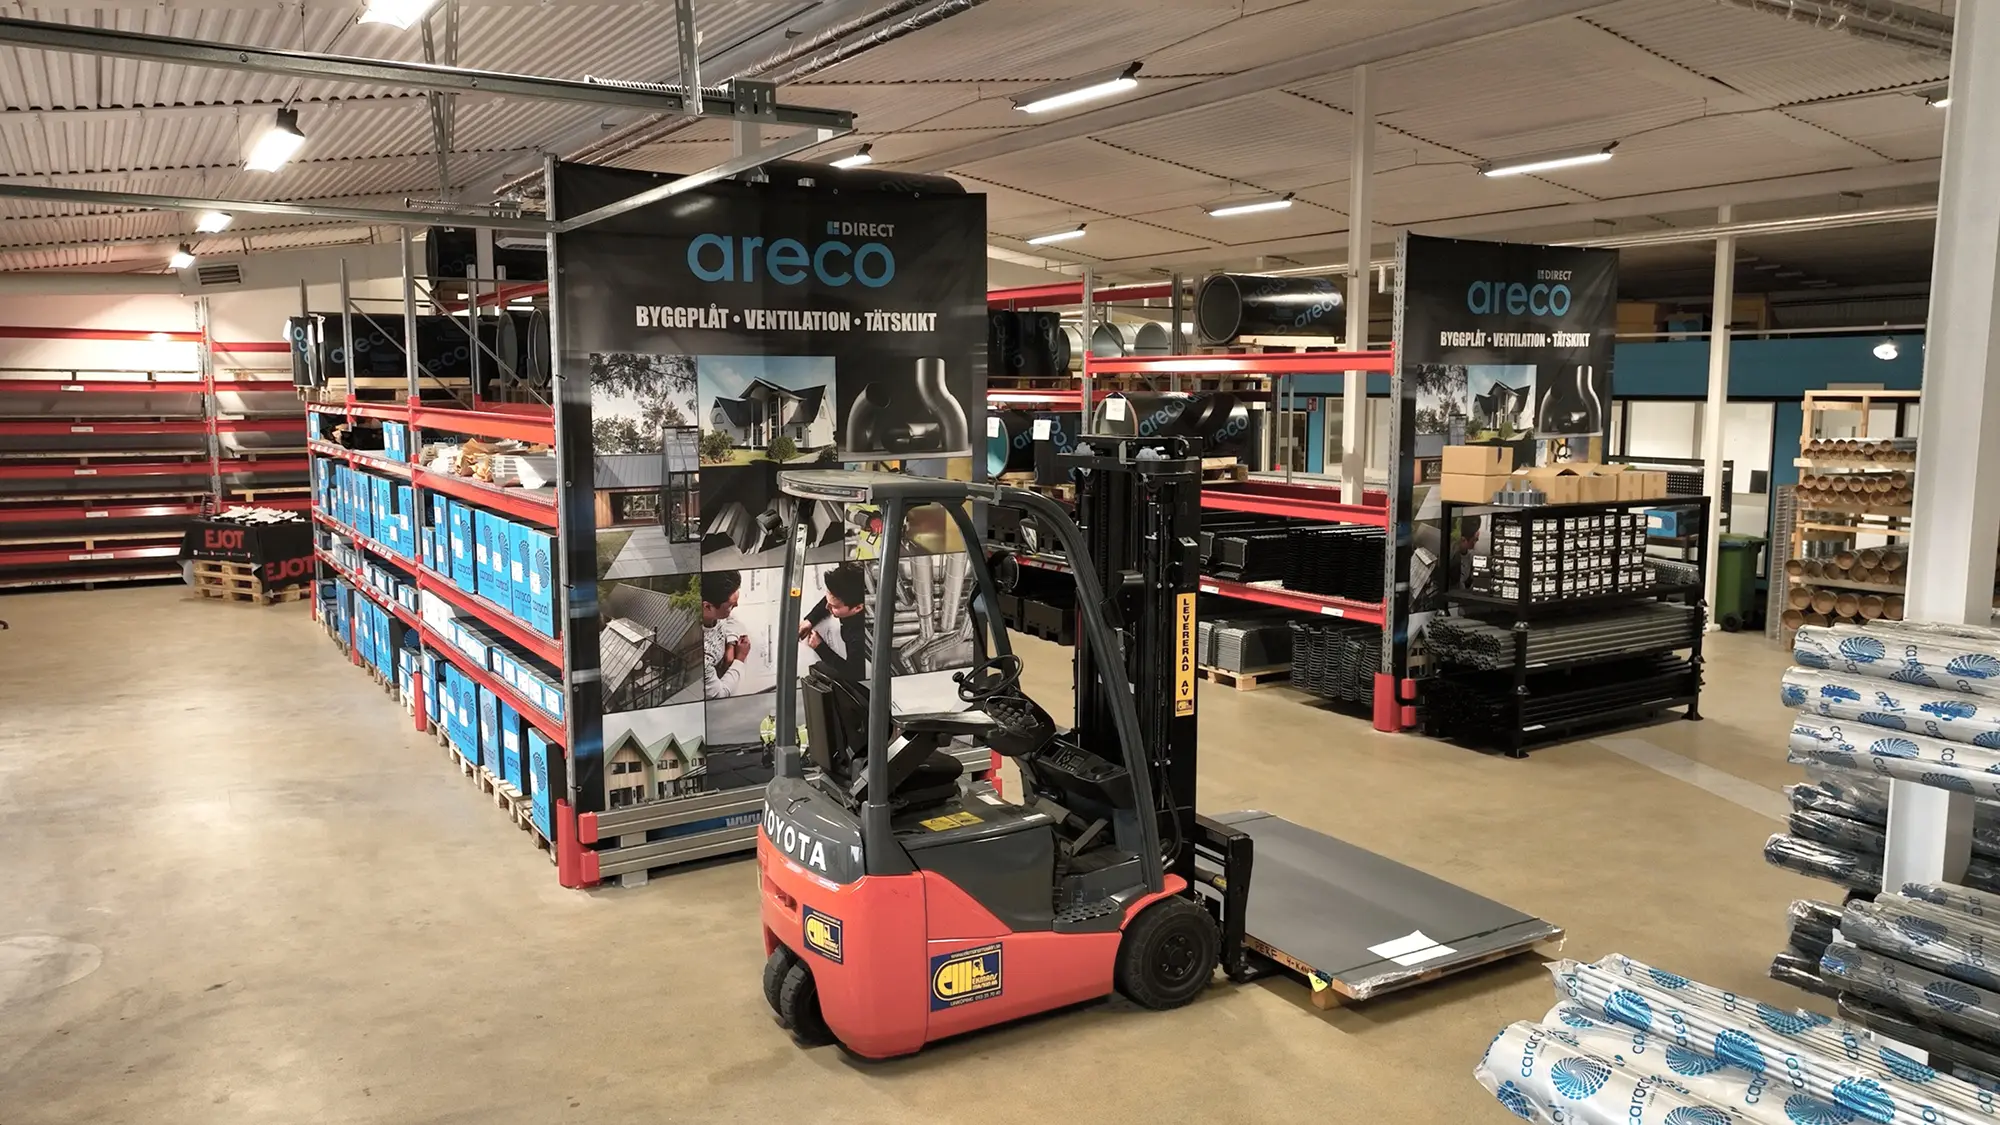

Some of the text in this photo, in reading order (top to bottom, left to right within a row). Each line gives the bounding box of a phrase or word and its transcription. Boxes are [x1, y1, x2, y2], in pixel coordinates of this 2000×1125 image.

[841, 221, 895, 238] DIRECT
[687, 233, 896, 288] areco
[1545, 270, 1572, 281] DIRECT
[1294, 293, 1341, 328] areco
[1467, 281, 1571, 316] areco
[635, 302, 937, 332] BYGGPLÅT VENTILATION TÄTSKIKT
[1440, 329, 1591, 347] BYGGPLÅT VENTILATION TÄTSKIKT
[1139, 399, 1187, 436] areco
[205, 530, 244, 549] EJOT
[265, 556, 315, 580] EJOT
[1181, 598, 1190, 672] LEVERERAD
[1181, 680, 1189, 696] AV
[764, 800, 827, 872] TOYOTA
